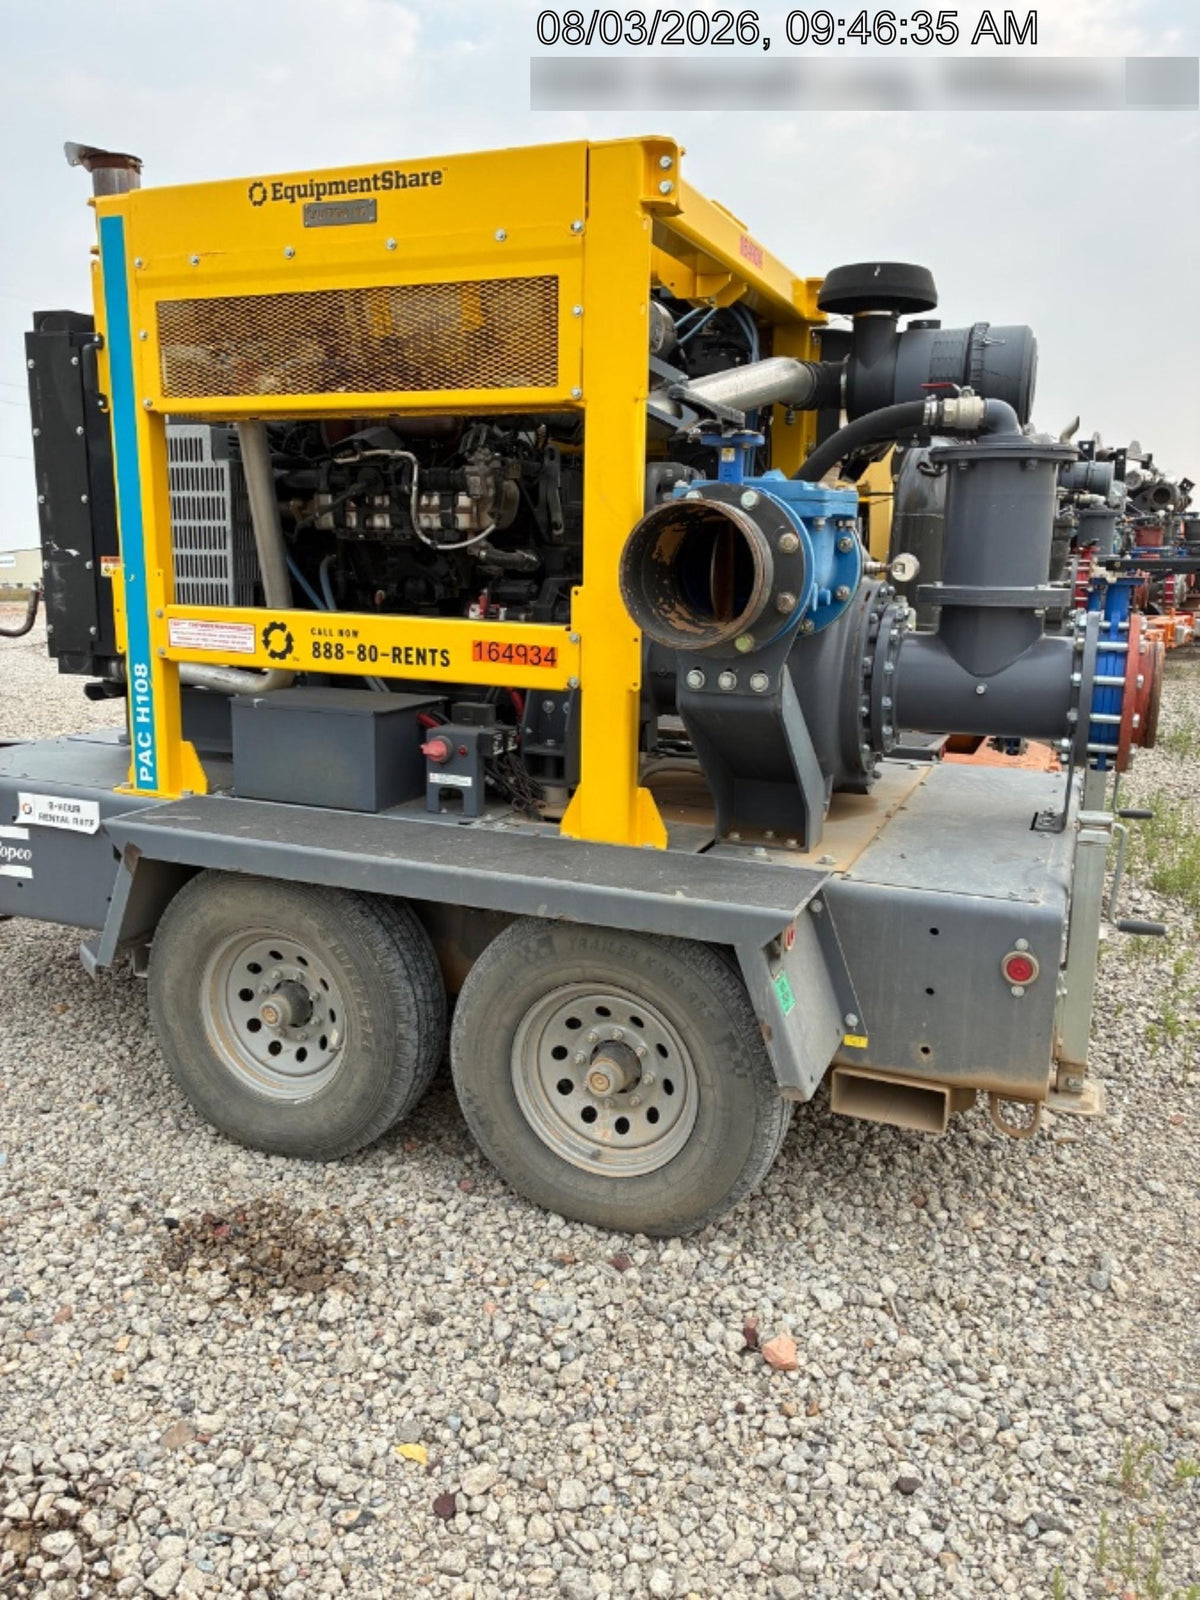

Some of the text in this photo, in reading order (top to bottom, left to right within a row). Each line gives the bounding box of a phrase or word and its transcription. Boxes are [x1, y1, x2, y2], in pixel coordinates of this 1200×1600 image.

[271, 170, 442, 203] EquipmentShare
[310, 627, 359, 639] CALL NOW
[311, 641, 451, 668] 888-80-RENTS
[474, 640, 558, 667] 164934
[134, 663, 154, 782] PAC H108
[0, 841, 33, 862] opco
